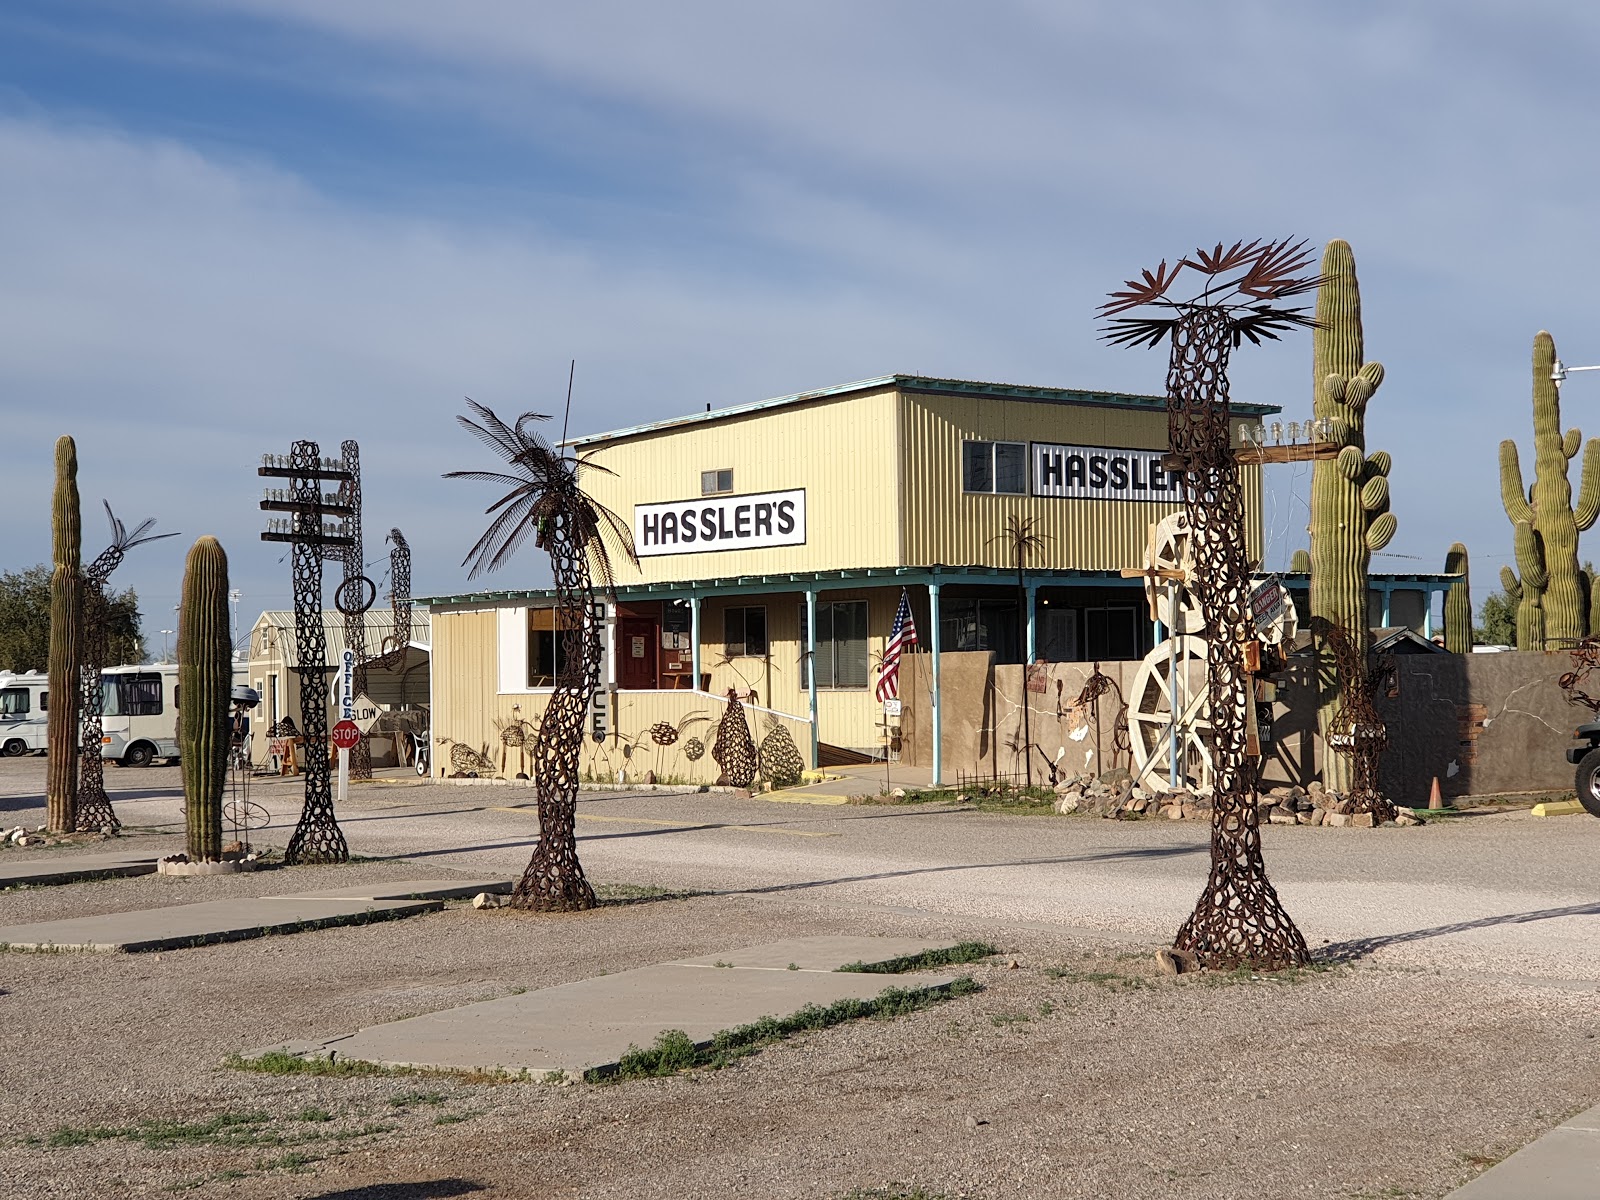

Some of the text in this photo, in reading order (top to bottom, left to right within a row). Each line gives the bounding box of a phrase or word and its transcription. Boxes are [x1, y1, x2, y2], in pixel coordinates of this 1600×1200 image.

[1043, 453, 1200, 493] HASSLE
[643, 500, 795, 546] HASSLER'S
[1254, 588, 1278, 612] DANGER
[343, 651, 353, 719] OFFICE
[592, 602, 605, 731] OICE
[351, 708, 376, 720] SLOW
[333, 729, 358, 740] STOP
